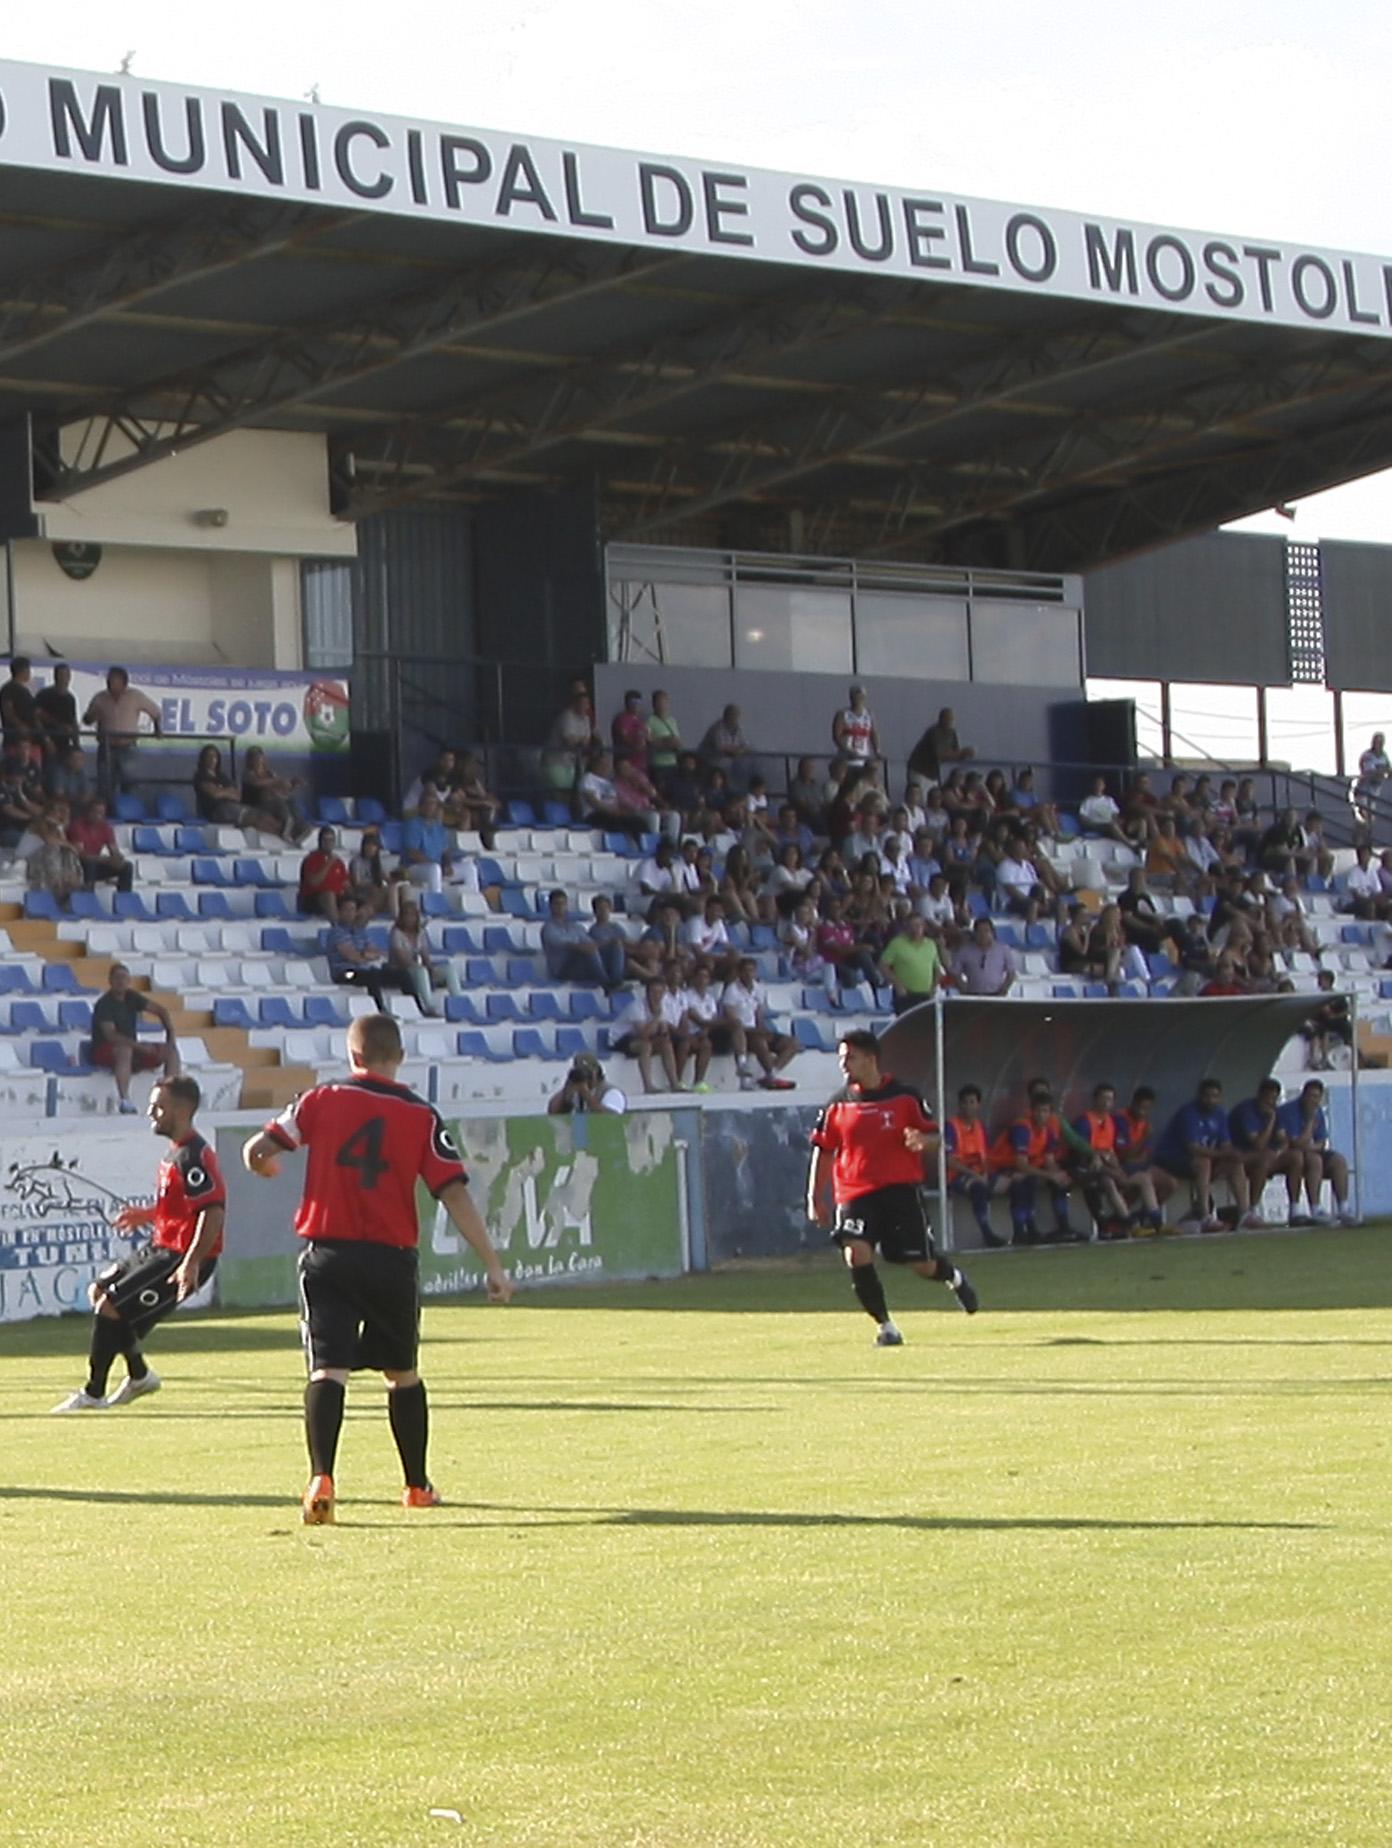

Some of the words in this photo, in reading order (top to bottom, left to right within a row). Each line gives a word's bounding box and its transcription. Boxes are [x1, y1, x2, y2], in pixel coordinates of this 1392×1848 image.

[49, 77, 614, 230] MUNICIPAL
[638, 161, 755, 248] DE
[787, 181, 1059, 284] SUELO
[1083, 221, 1392, 328] MOSTOL
[161, 697, 195, 732] EL
[207, 699, 298, 737] SOTO
[335, 1116, 391, 1191] 4
